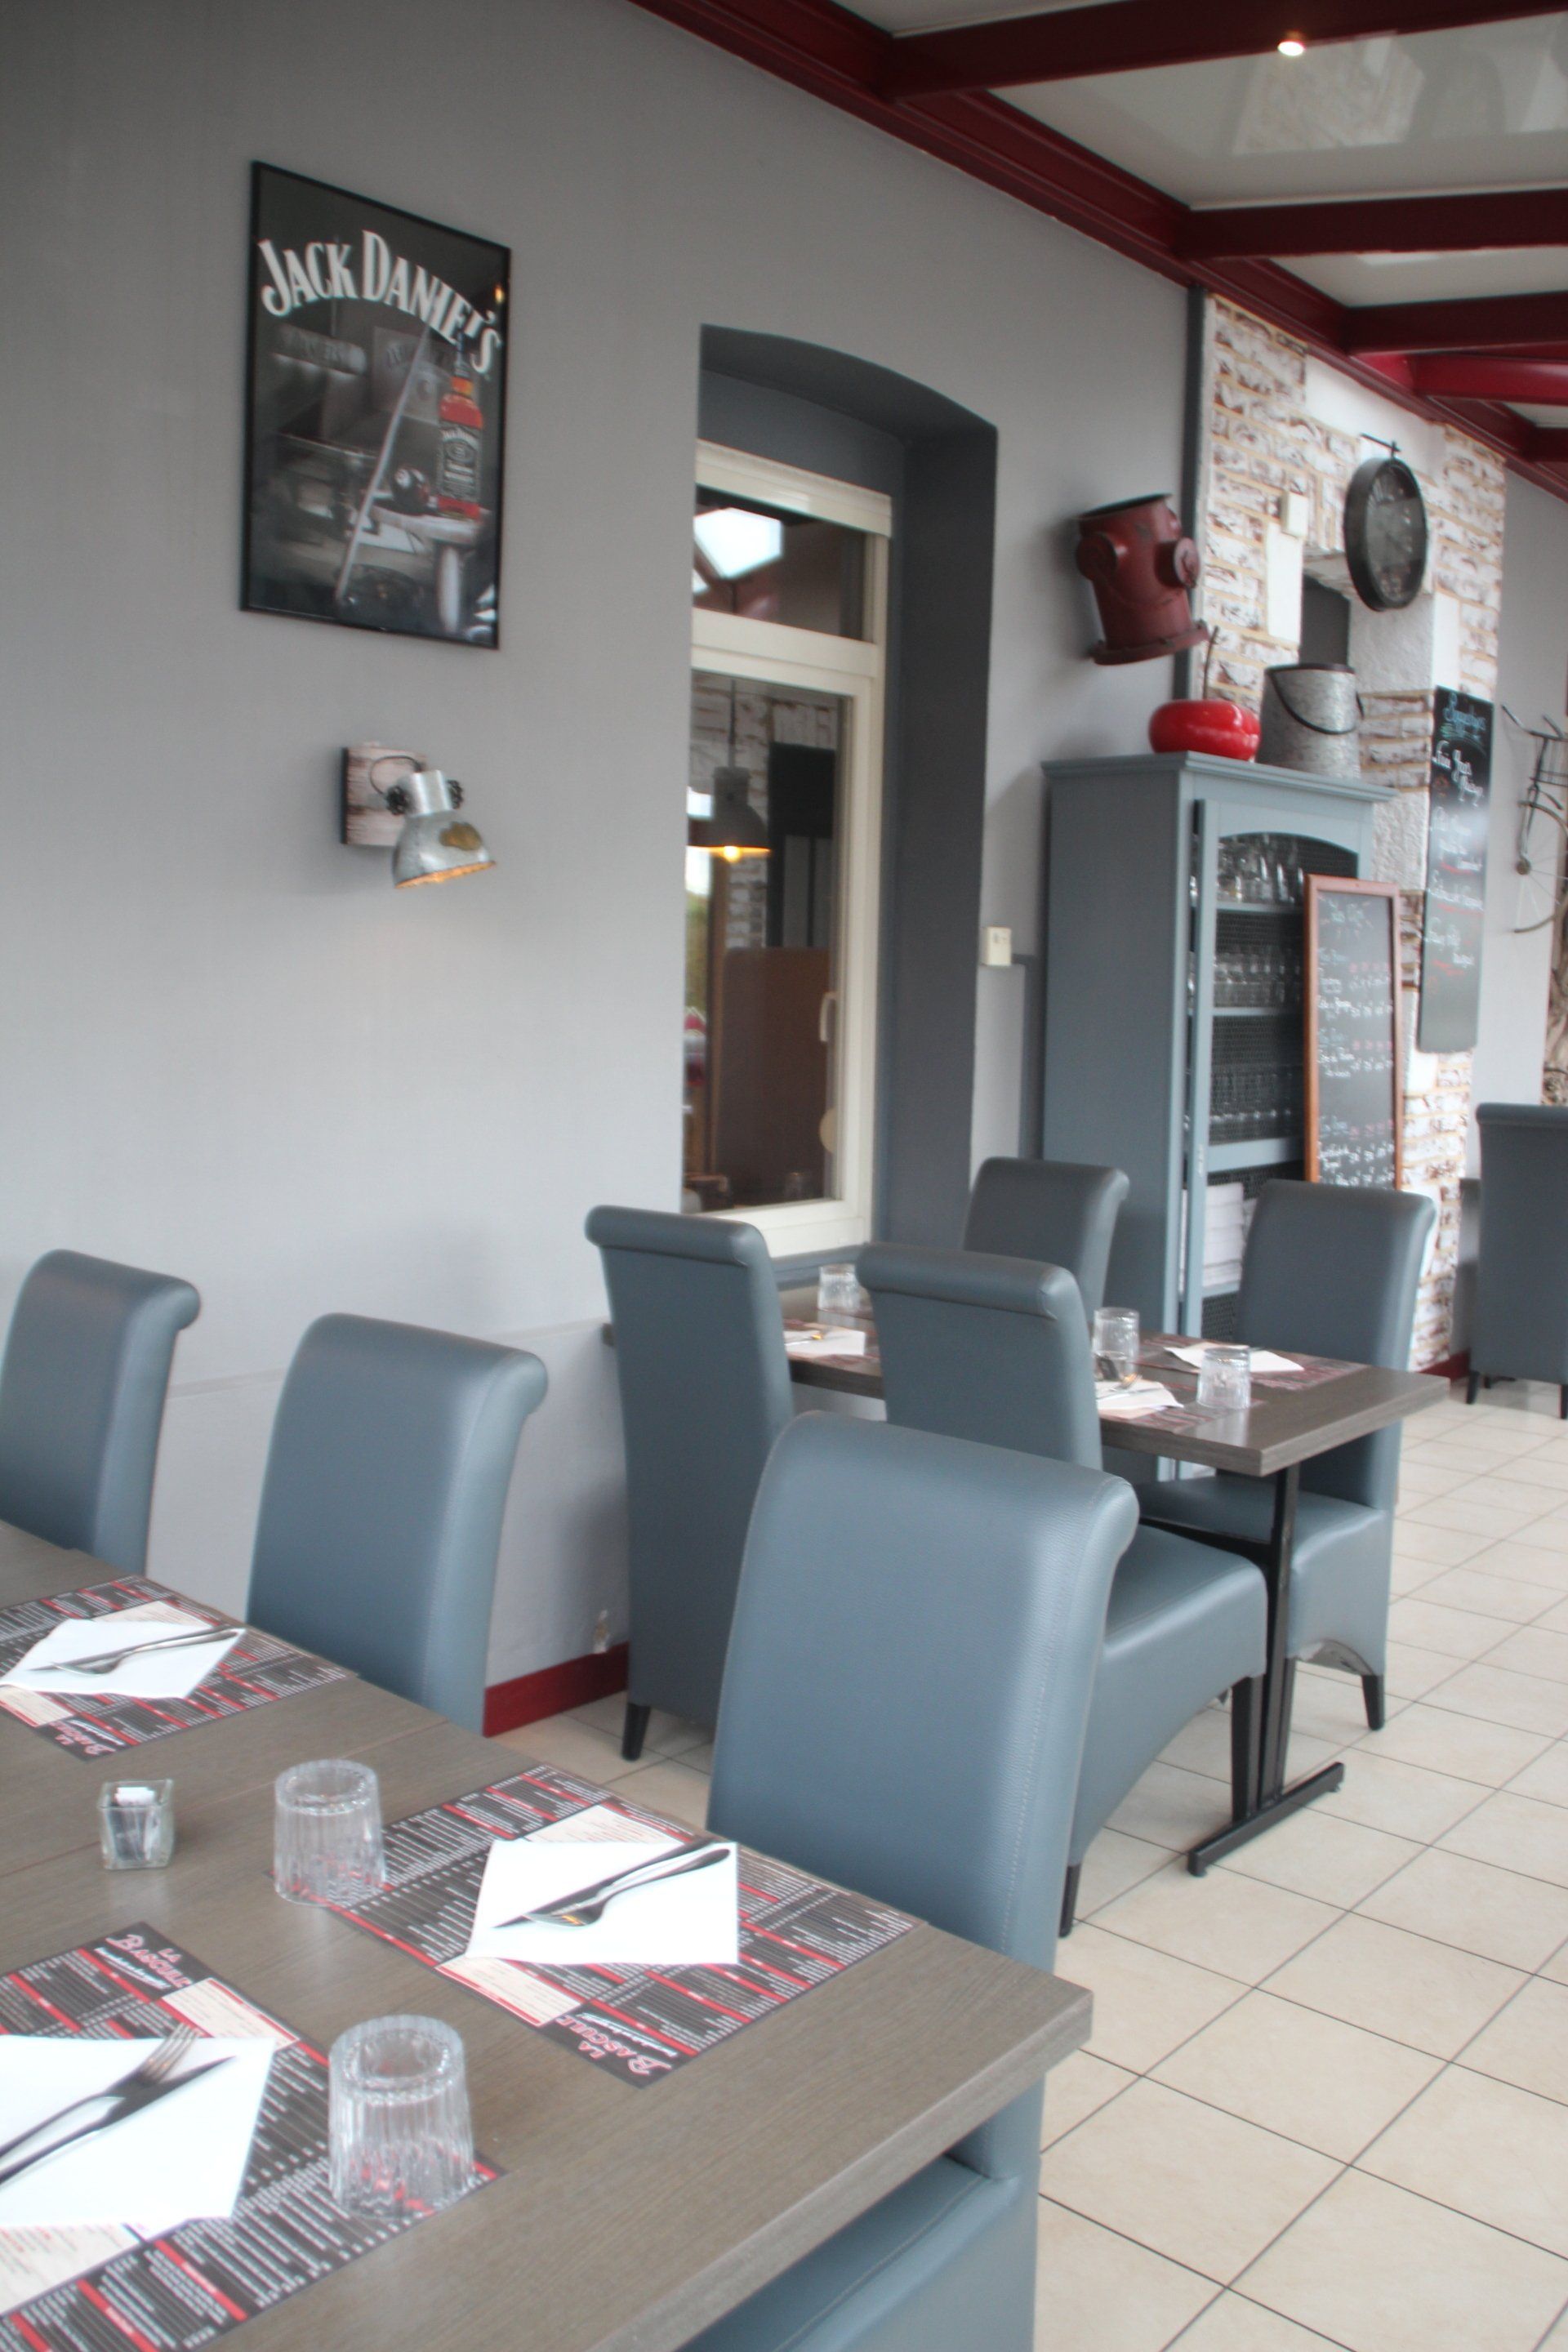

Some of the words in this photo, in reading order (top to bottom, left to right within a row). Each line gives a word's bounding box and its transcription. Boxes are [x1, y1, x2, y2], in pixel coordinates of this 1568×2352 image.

[258, 239, 359, 317] JACK
[555, 2015, 672, 2075] BASCULE
[577, 2040, 606, 2059] LA
